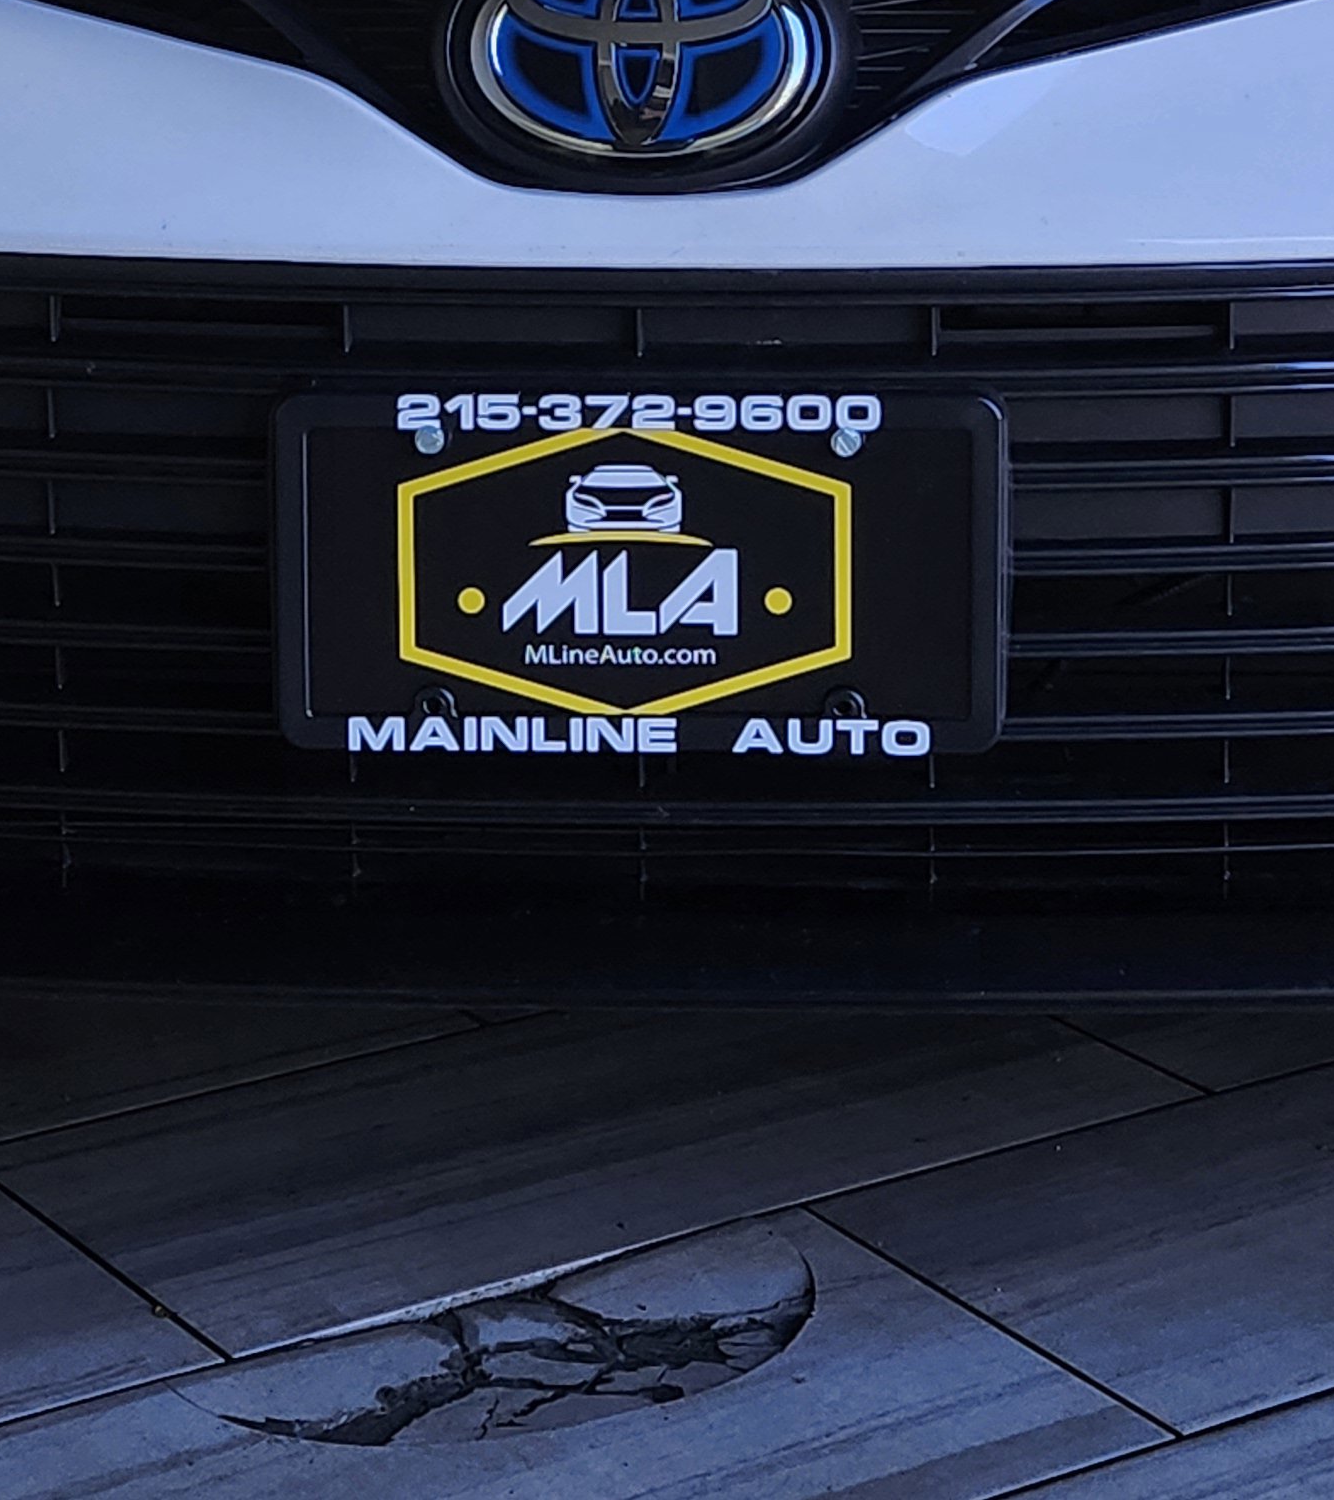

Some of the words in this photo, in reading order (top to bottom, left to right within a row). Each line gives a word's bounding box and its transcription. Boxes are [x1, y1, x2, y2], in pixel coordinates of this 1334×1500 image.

[396, 393, 883, 432] 215-372-9600
[501, 548, 740, 636] MLA
[523, 643, 717, 666] MLineAuto.com
[347, 716, 678, 754] MAINLINE
[731, 718, 932, 757] AUTO
